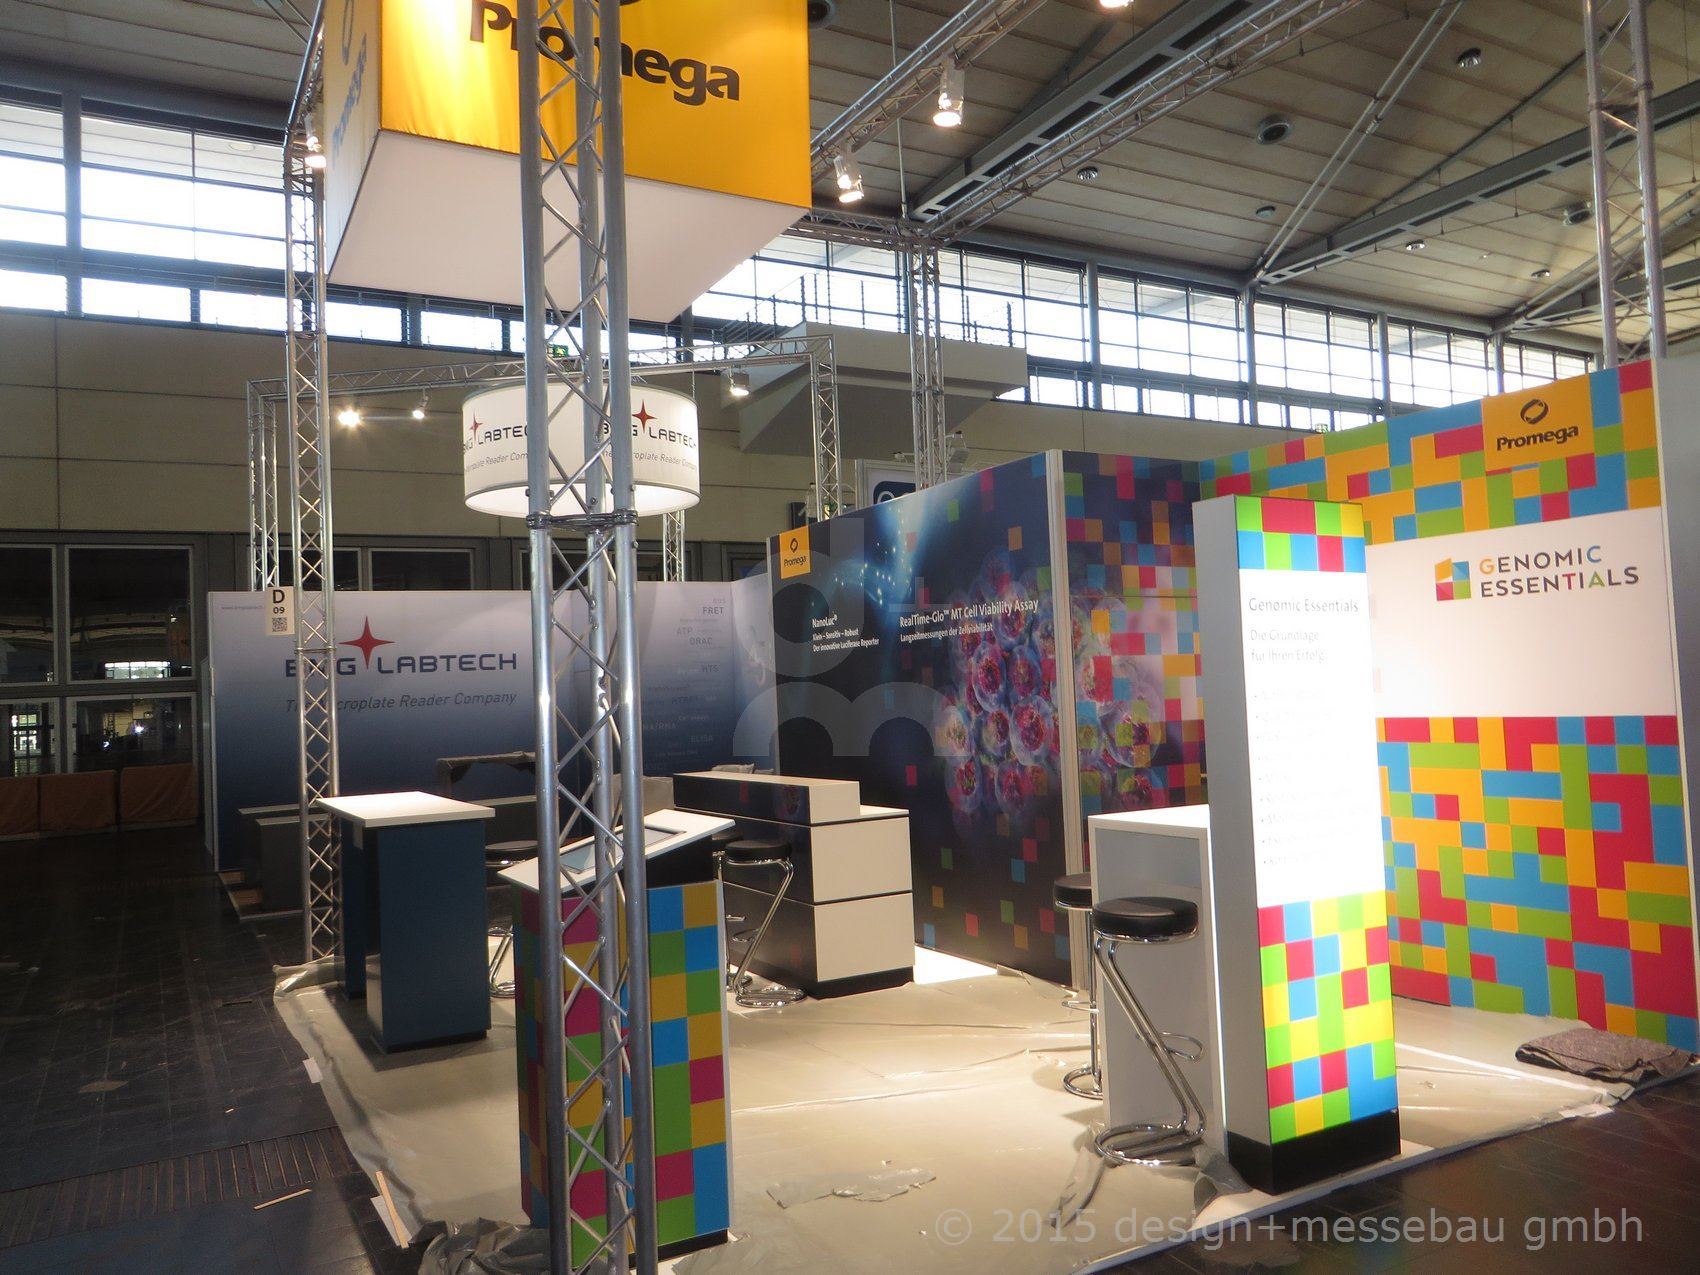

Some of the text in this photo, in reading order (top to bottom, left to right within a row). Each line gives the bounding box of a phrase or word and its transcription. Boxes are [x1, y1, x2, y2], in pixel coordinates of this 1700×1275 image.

[1496, 425, 1579, 451] Promega
[784, 556, 807, 568] Promega
[1479, 545, 1602, 575] GENOMIC
[1480, 566, 1639, 598] ESSENTIALS
[272, 589, 285, 604] D
[272, 606, 285, 614] 09
[702, 606, 724, 615] FRET
[1249, 597, 1359, 612] Genomic Essentials
[900, 599, 1039, 628] RealTime-Glo™ MT Cell Viability Assay
[677, 627, 693, 636] ATP
[900, 629, 949, 643] Langzeitmessungen
[949, 627, 958, 636] der
[689, 637, 713, 646] ORAC
[861, 638, 880, 648] Reporter
[377, 653, 517, 674] LABTECH
[399, 693, 450, 709] Reader
[454, 692, 517, 706] Company
